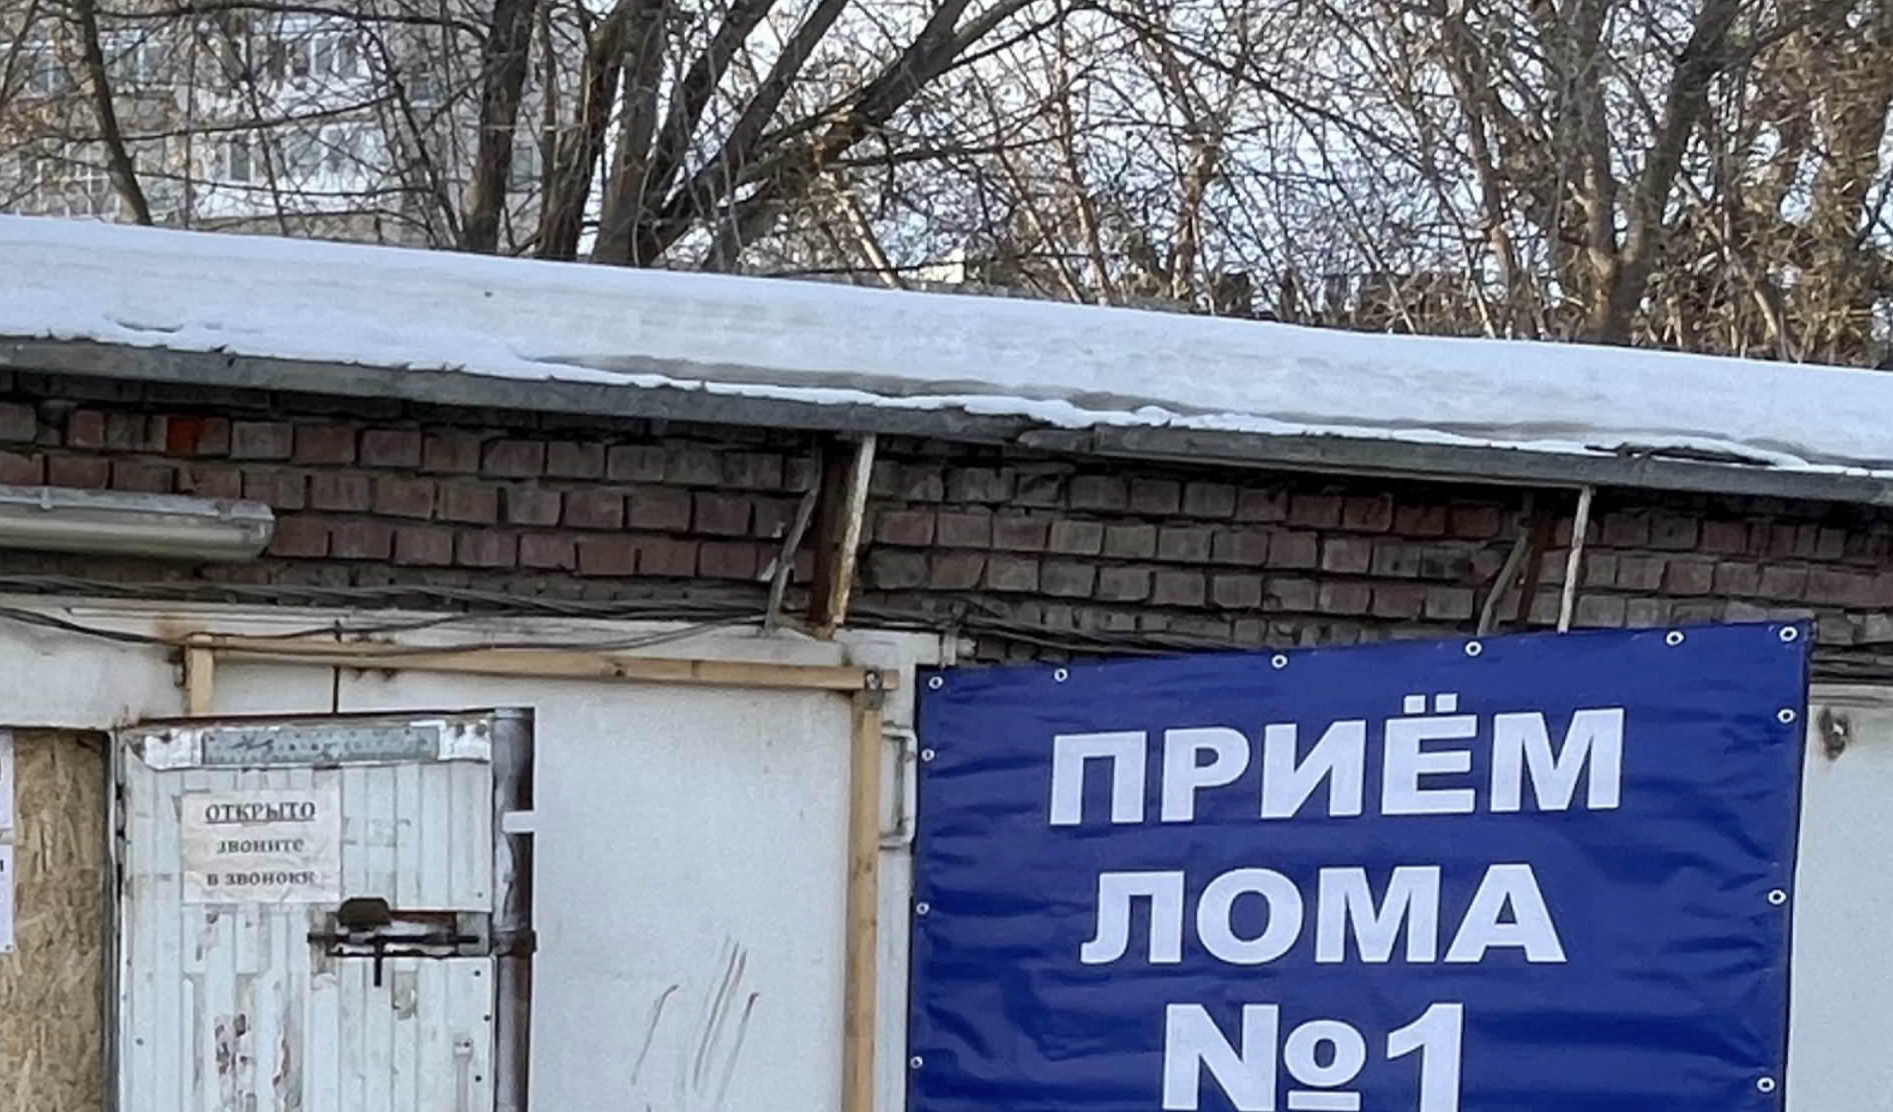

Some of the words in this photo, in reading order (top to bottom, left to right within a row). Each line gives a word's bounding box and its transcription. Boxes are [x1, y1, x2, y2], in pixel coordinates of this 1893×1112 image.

[1048, 692, 1625, 826] ПРИЁМ
[204, 802, 316, 824] ОТКРЫТО
[1080, 862, 1567, 965] ЛОМА
